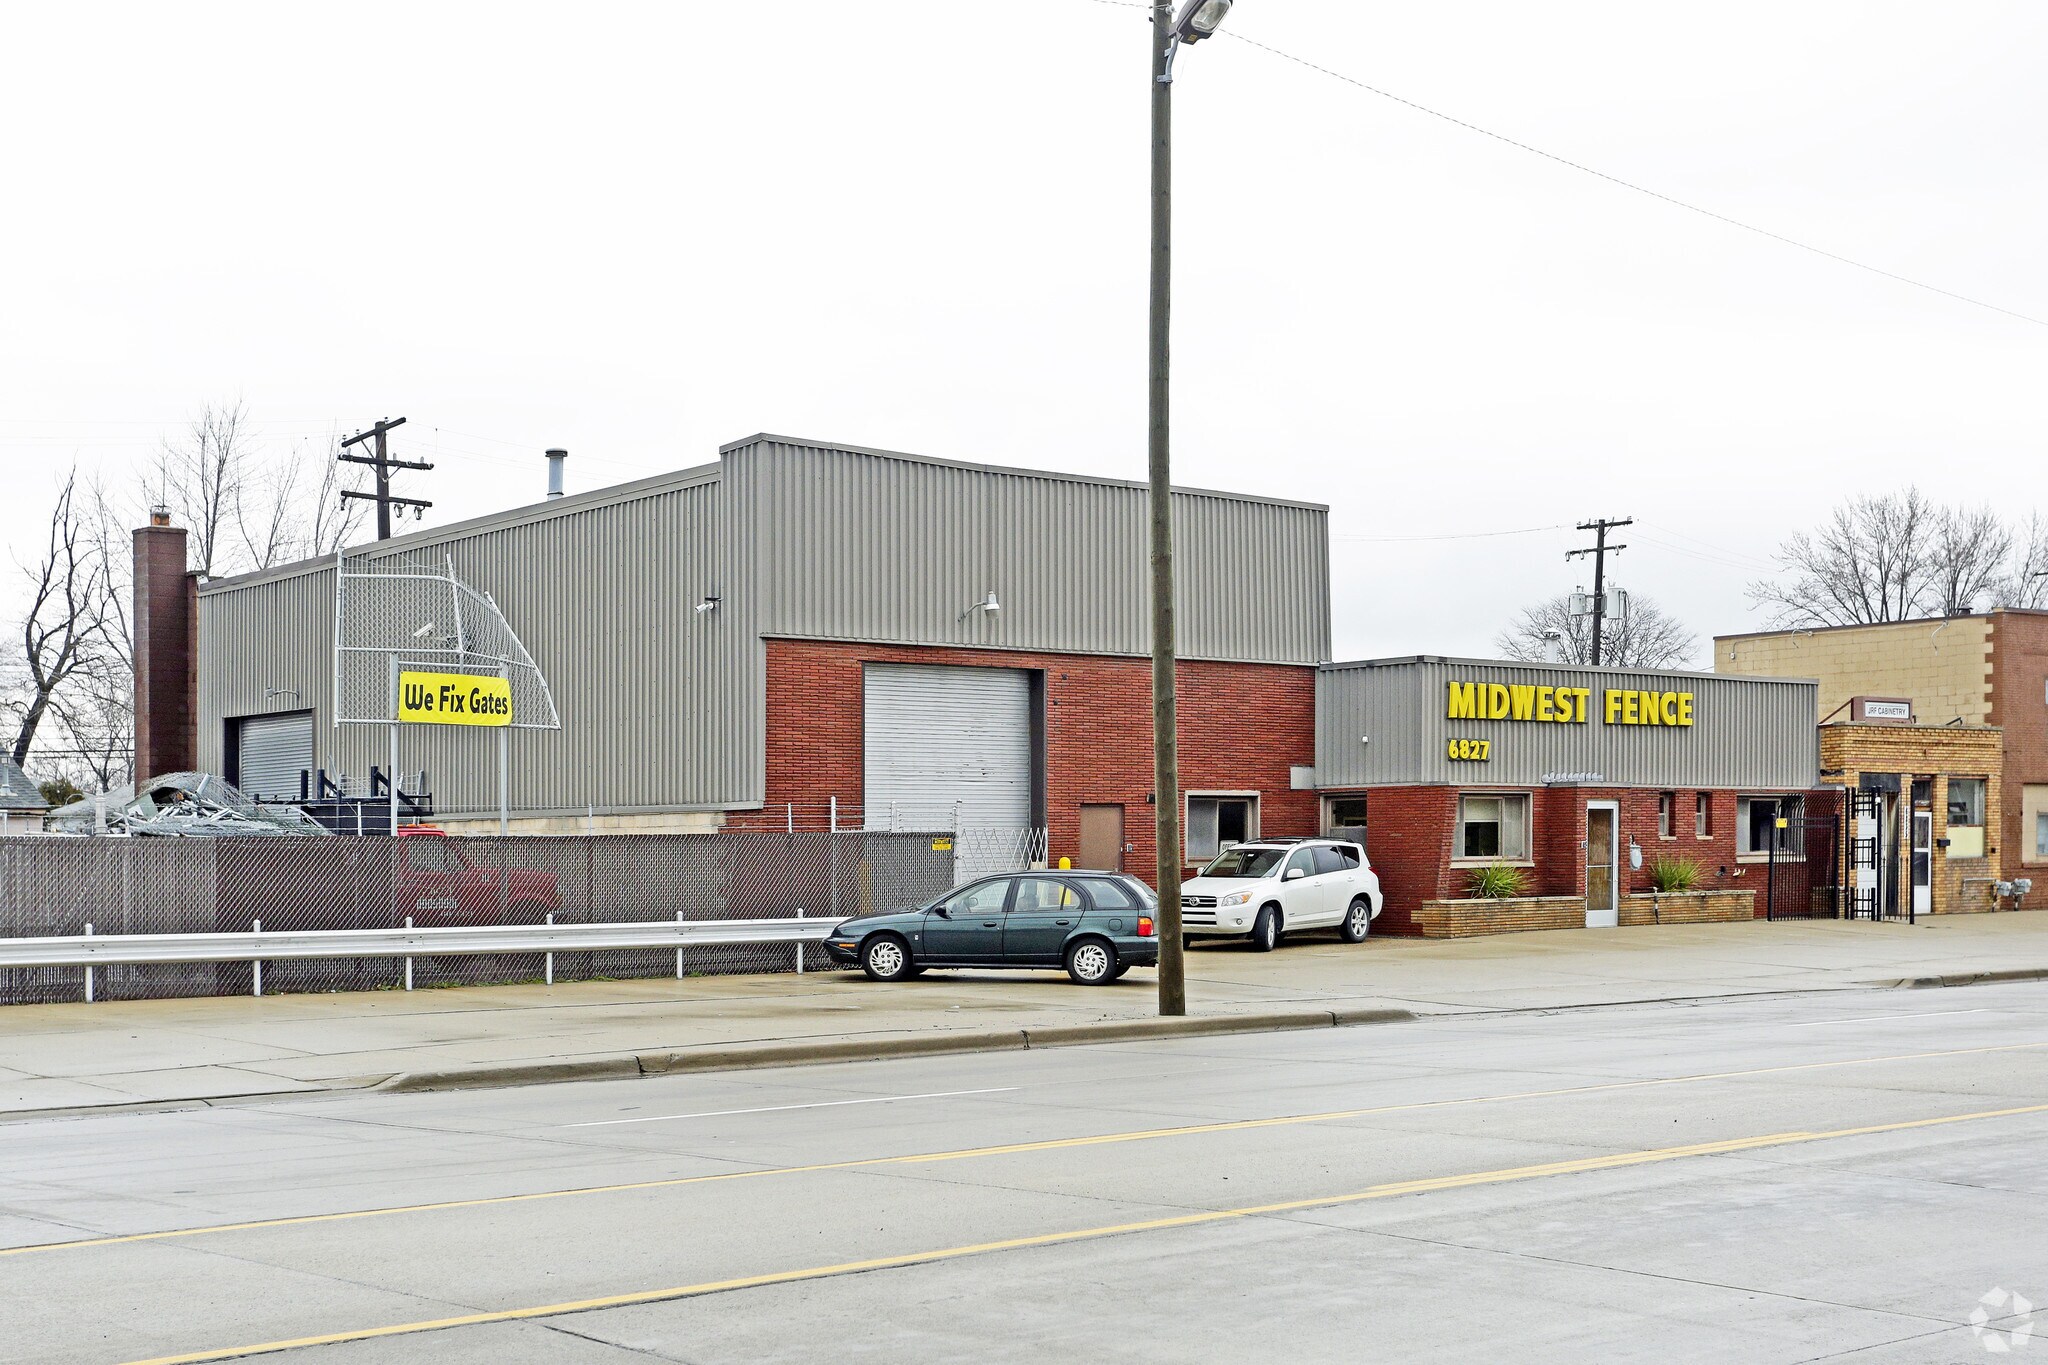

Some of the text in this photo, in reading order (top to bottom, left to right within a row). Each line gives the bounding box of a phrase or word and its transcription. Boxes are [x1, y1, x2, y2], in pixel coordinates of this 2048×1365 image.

[405, 684, 508, 715] We Fix Gates
[1447, 681, 1694, 726] MIDWEST FENCE
[1877, 707, 1906, 715] CABINETRY
[1448, 739, 1490, 760] 6827
